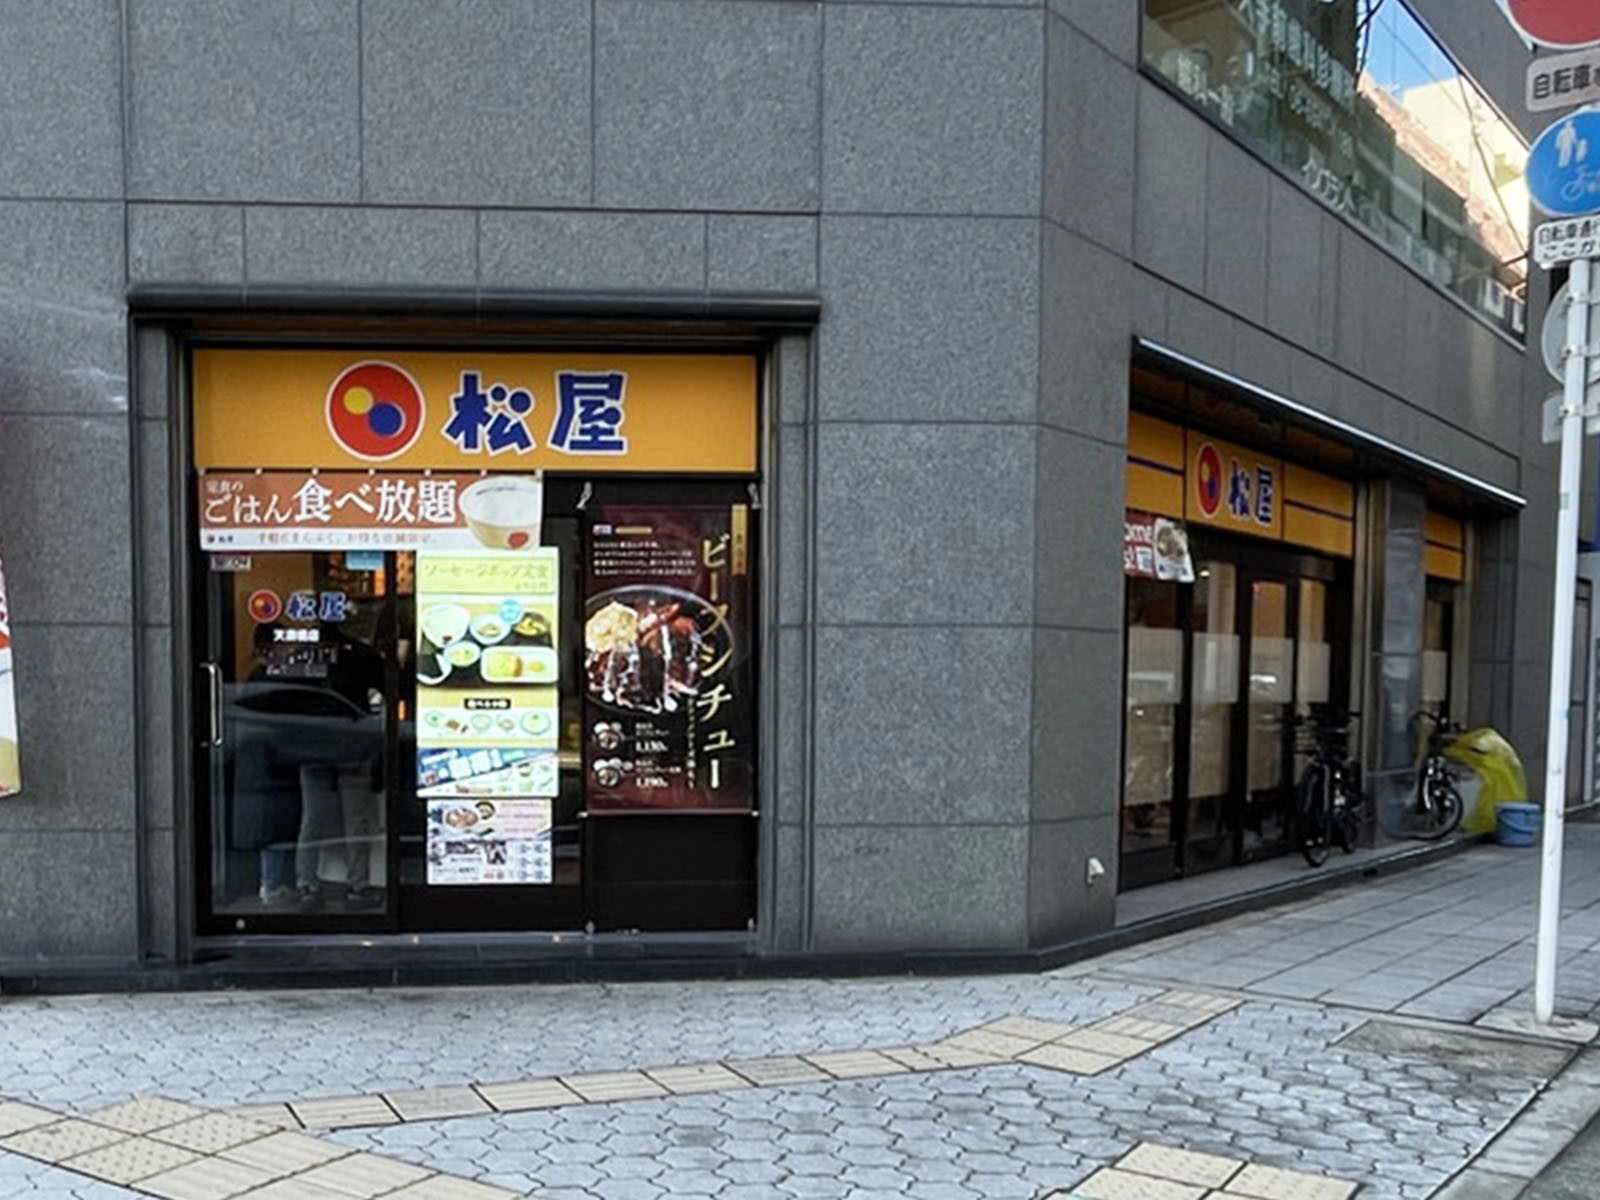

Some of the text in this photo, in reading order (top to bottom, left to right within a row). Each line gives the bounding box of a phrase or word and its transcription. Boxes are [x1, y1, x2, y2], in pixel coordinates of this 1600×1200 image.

[1544, 240, 1600, 260] ここか
[442, 369, 629, 457] 松屋
[204, 478, 457, 524] ごはん食べ放題
[1226, 457, 1274, 527] 松屋
[697, 533, 736, 789] ビーフシチュー
